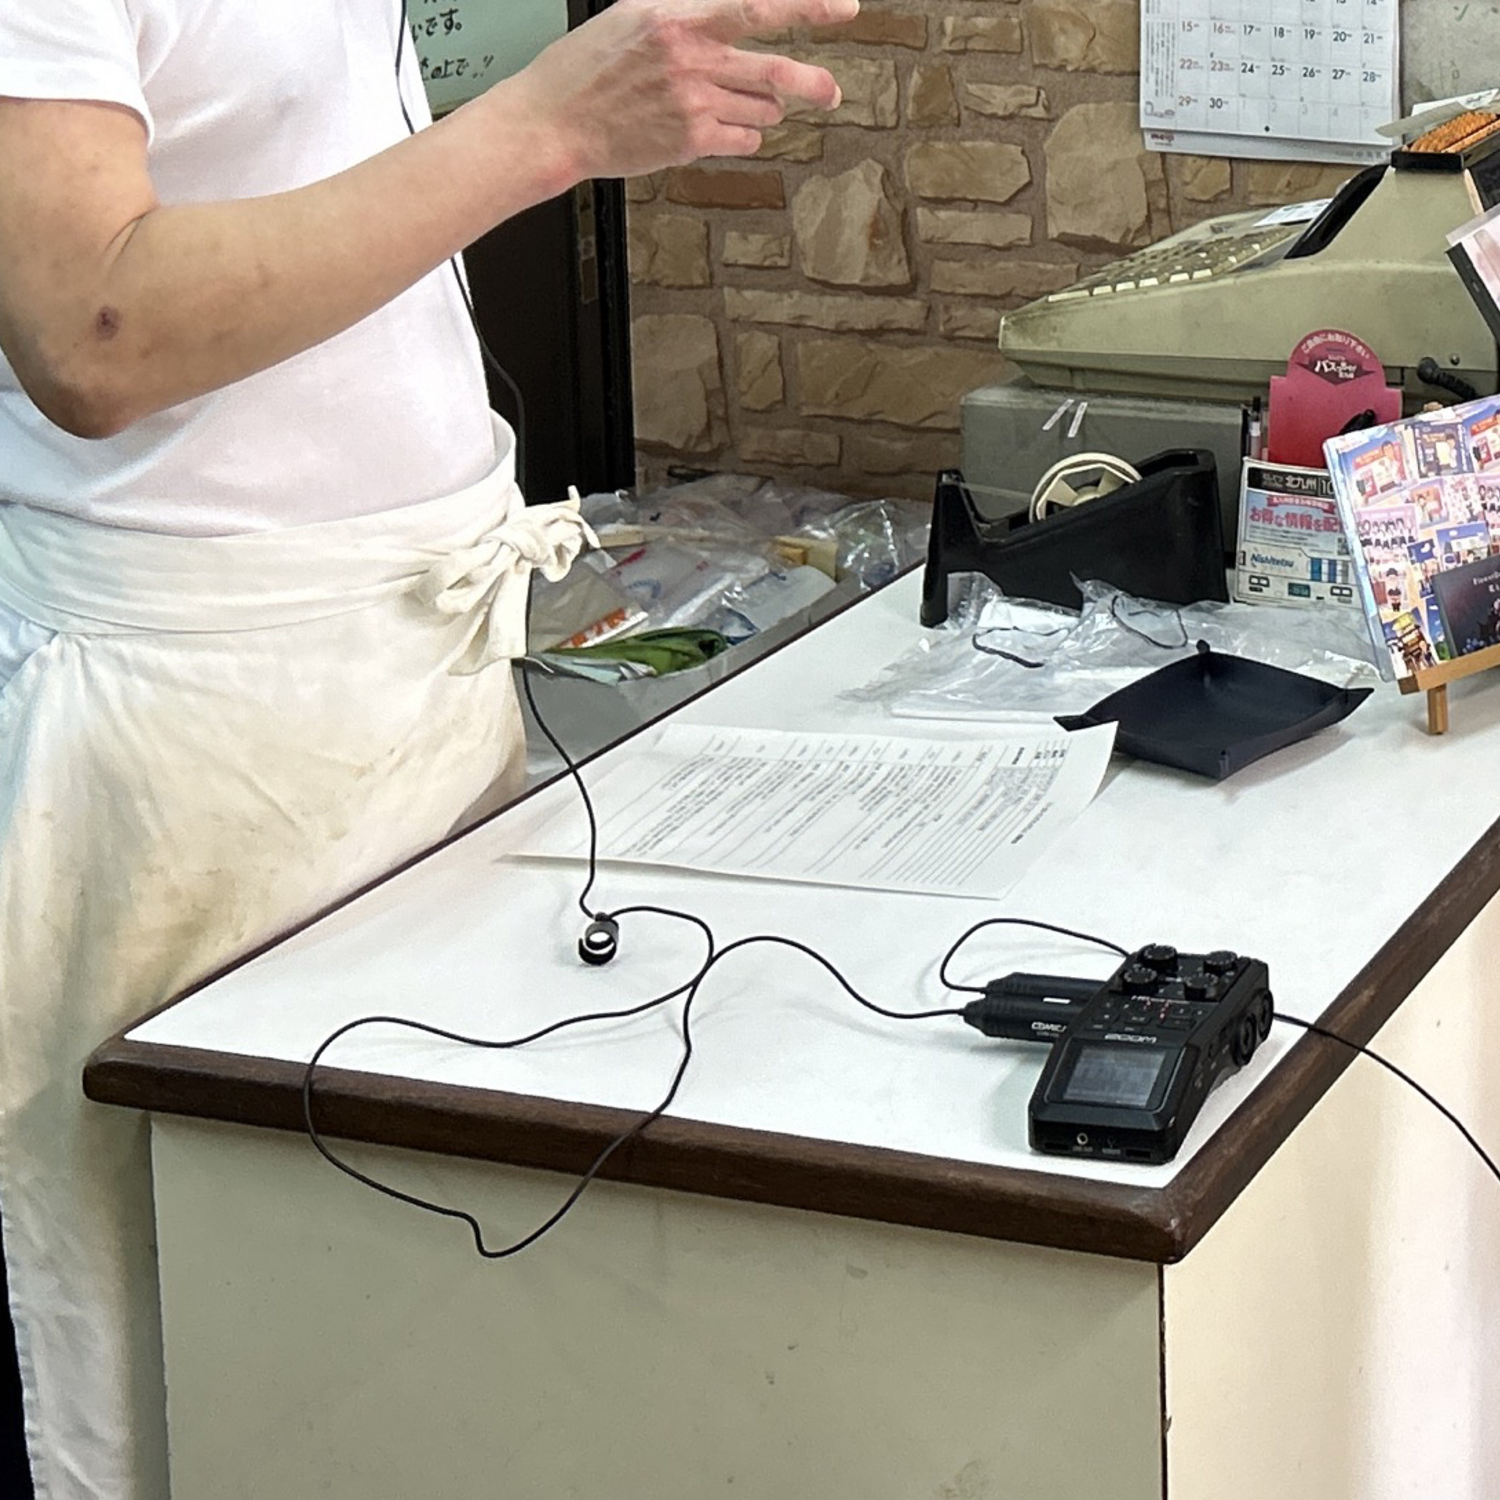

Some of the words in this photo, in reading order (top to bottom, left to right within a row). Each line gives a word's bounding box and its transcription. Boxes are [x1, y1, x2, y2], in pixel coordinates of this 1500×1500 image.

[1181, 21, 1193, 32] 15
[1213, 22, 1224, 34] 16
[1243, 25, 1255, 36] 17
[1274, 26, 1285, 38] 18
[1304, 29, 1315, 40] 19
[1332, 31, 1347, 42] 20
[1363, 33, 1375, 44] 21
[1180, 59, 1193, 69] 22
[1210, 60, 1224, 72] 23
[1241, 63, 1254, 74] 24
[1271, 65, 1285, 75] 25
[1302, 67, 1315, 78] 26
[1332, 69, 1345, 80] 27
[1362, 72, 1376, 82] 28
[1178, 96, 1192, 106] 29
[1209, 98, 1223, 109] 30
[1104, 1033, 1157, 1044] ZOOM
